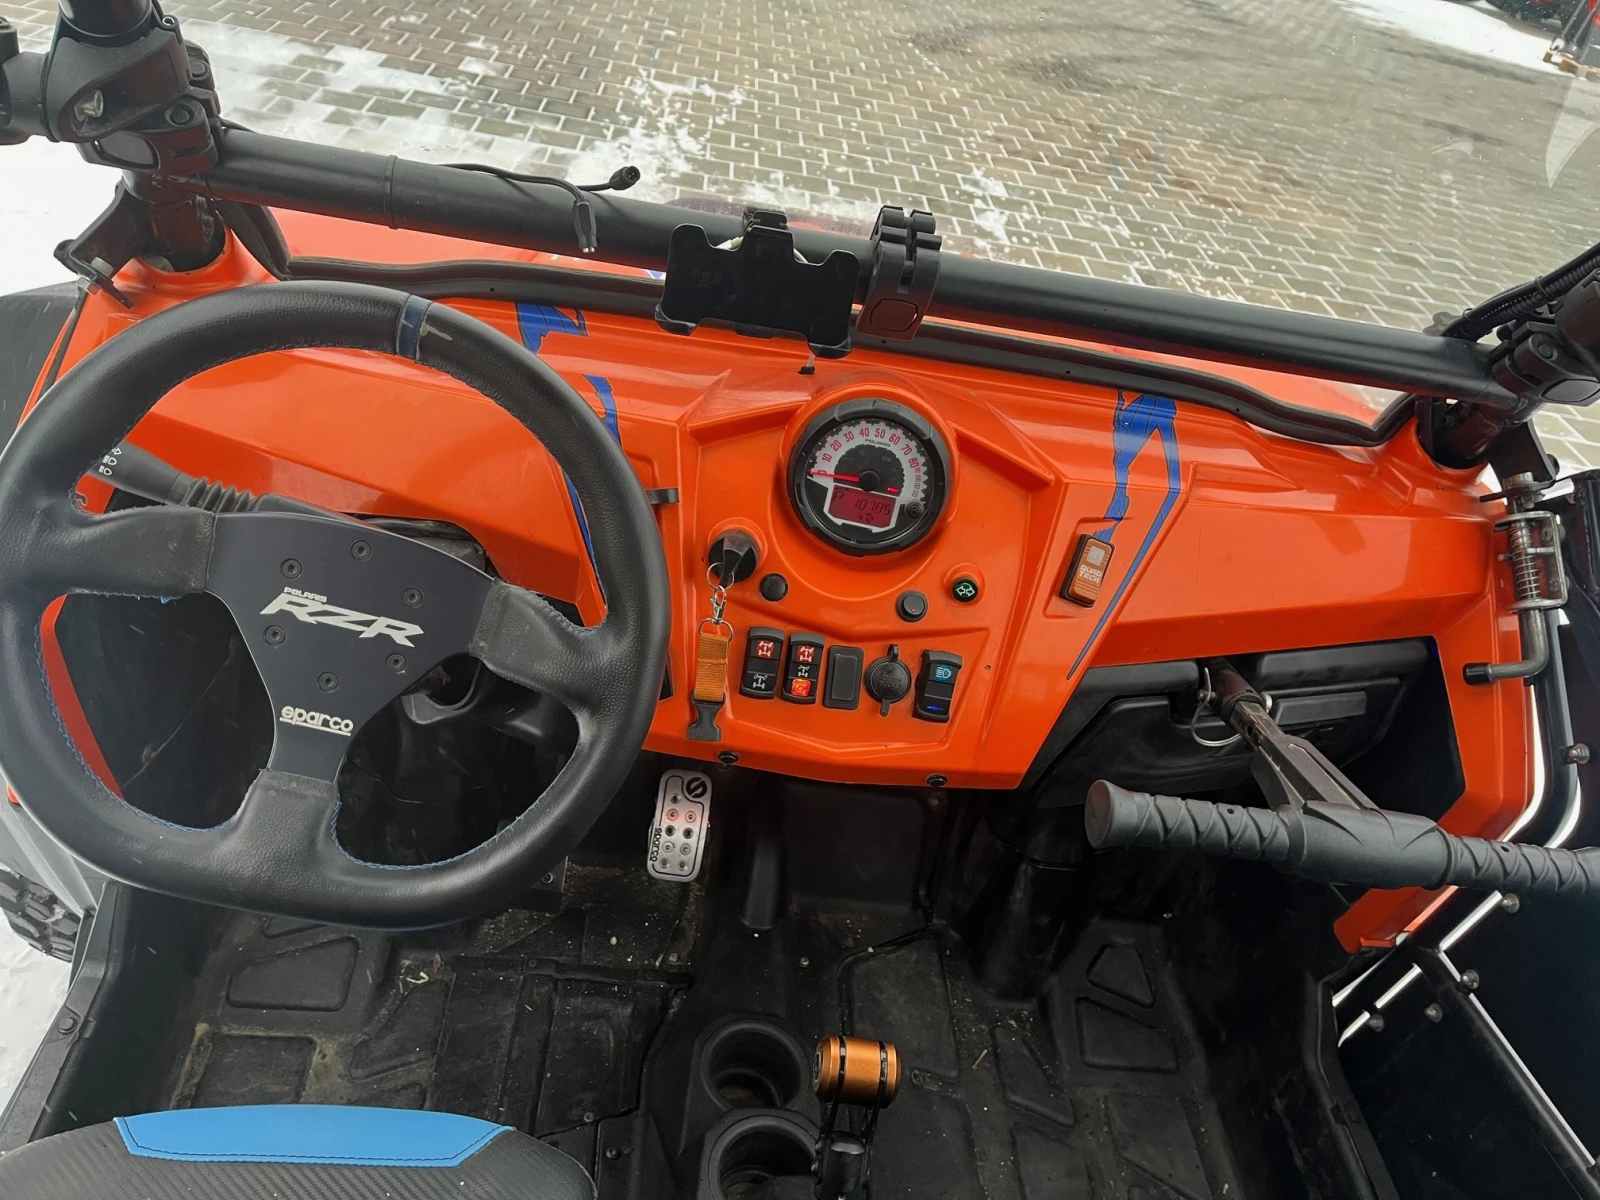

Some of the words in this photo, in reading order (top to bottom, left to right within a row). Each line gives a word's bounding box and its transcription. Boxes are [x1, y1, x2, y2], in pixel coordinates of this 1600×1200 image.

[822, 453, 832, 463] 10
[830, 439, 842, 452] 20
[843, 431, 855, 442] 30
[859, 428, 870, 437] 40
[875, 428, 886, 439] 50
[889, 433, 901, 445] 60
[901, 444, 912, 455] 70
[908, 457, 919, 469] 80
[865, 439, 891, 448] POLARIS
[1079, 571, 1100, 584] TECH
[284, 586, 327, 603] POLARIS
[259, 592, 424, 648] RZR
[281, 705, 353, 734] sparco
[651, 828, 662, 862] sparco
